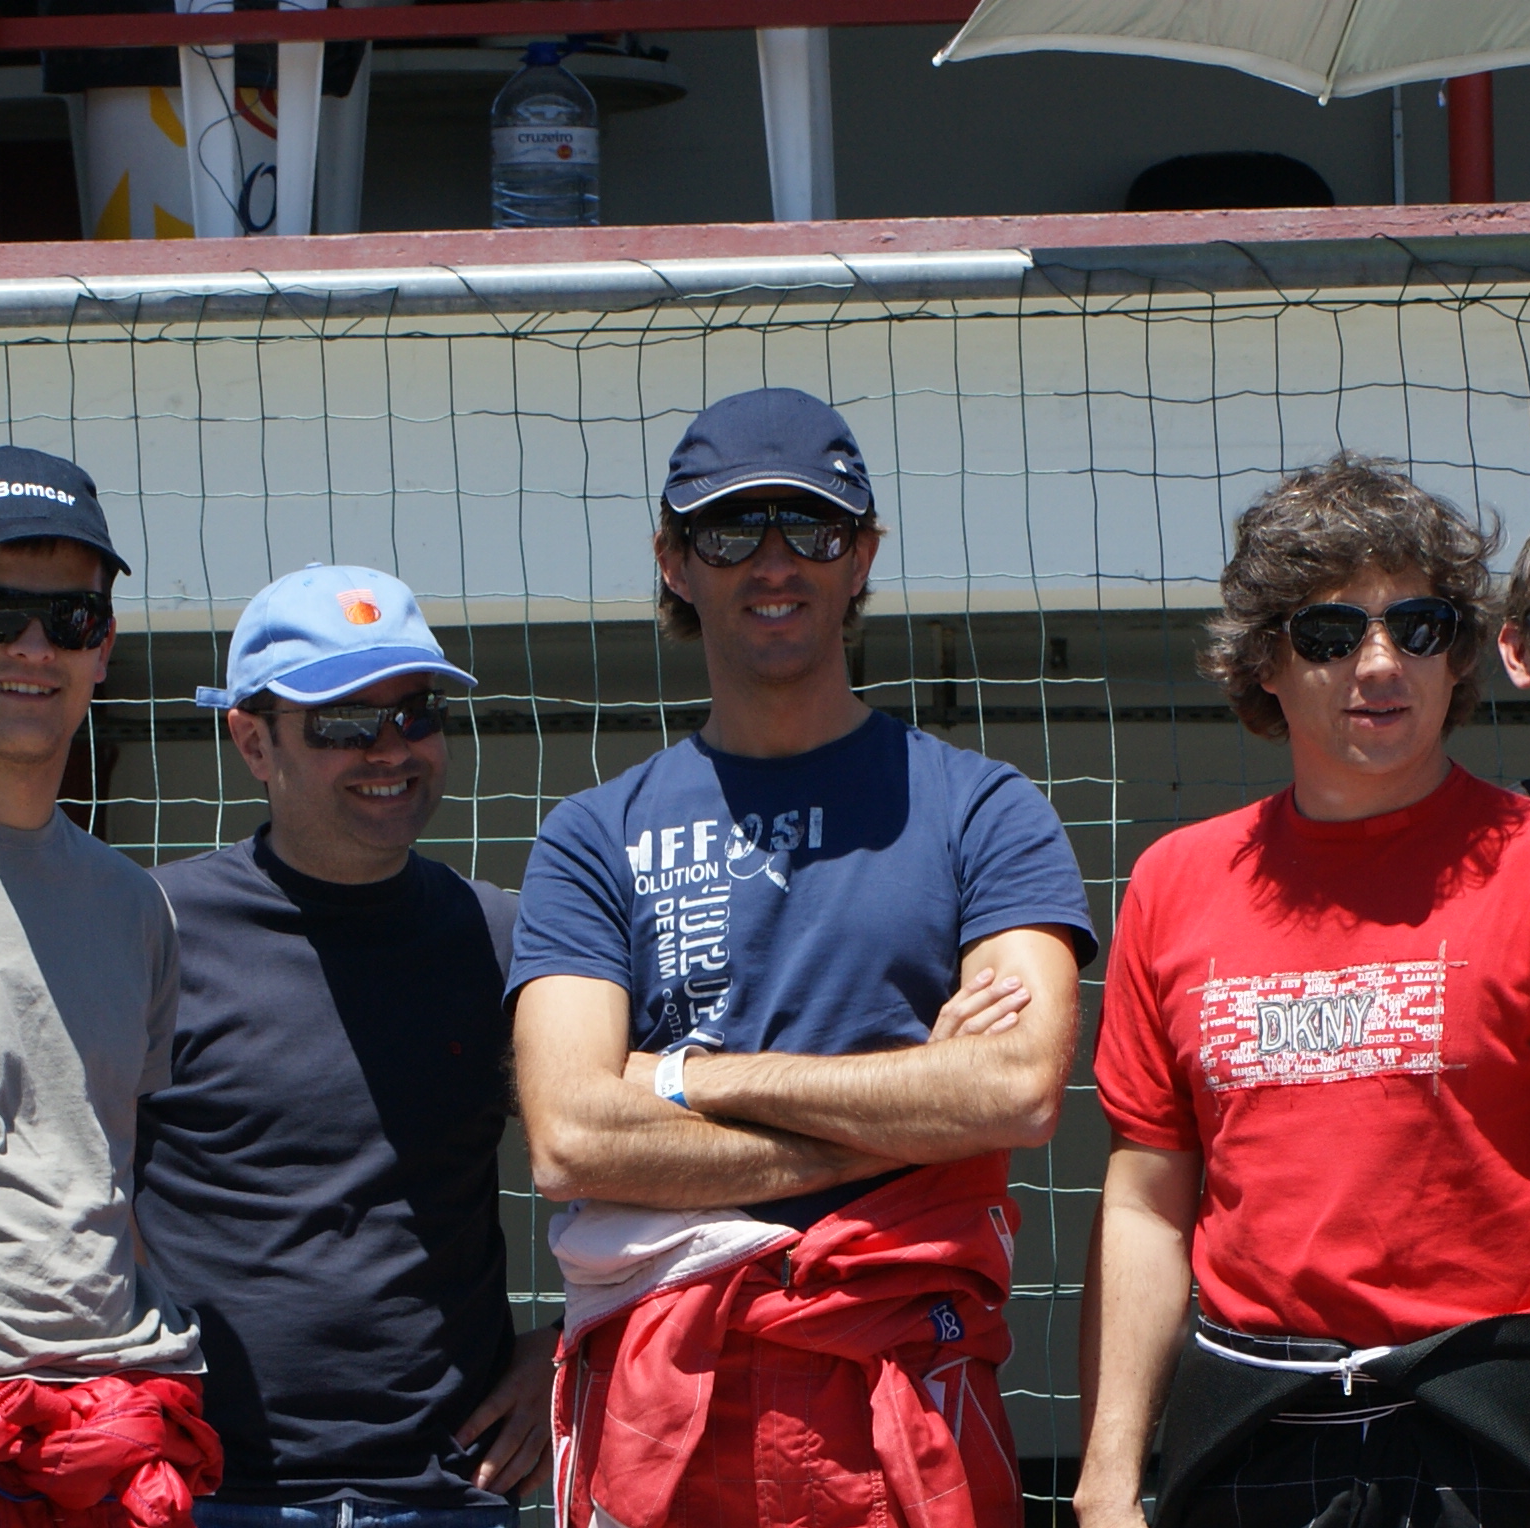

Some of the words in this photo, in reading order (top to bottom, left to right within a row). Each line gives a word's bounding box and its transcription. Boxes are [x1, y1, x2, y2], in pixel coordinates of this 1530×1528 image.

[518, 131, 573, 143] cruzeiro
[655, 898, 676, 980] DENIM
[1256, 990, 1377, 1054] DKNY
